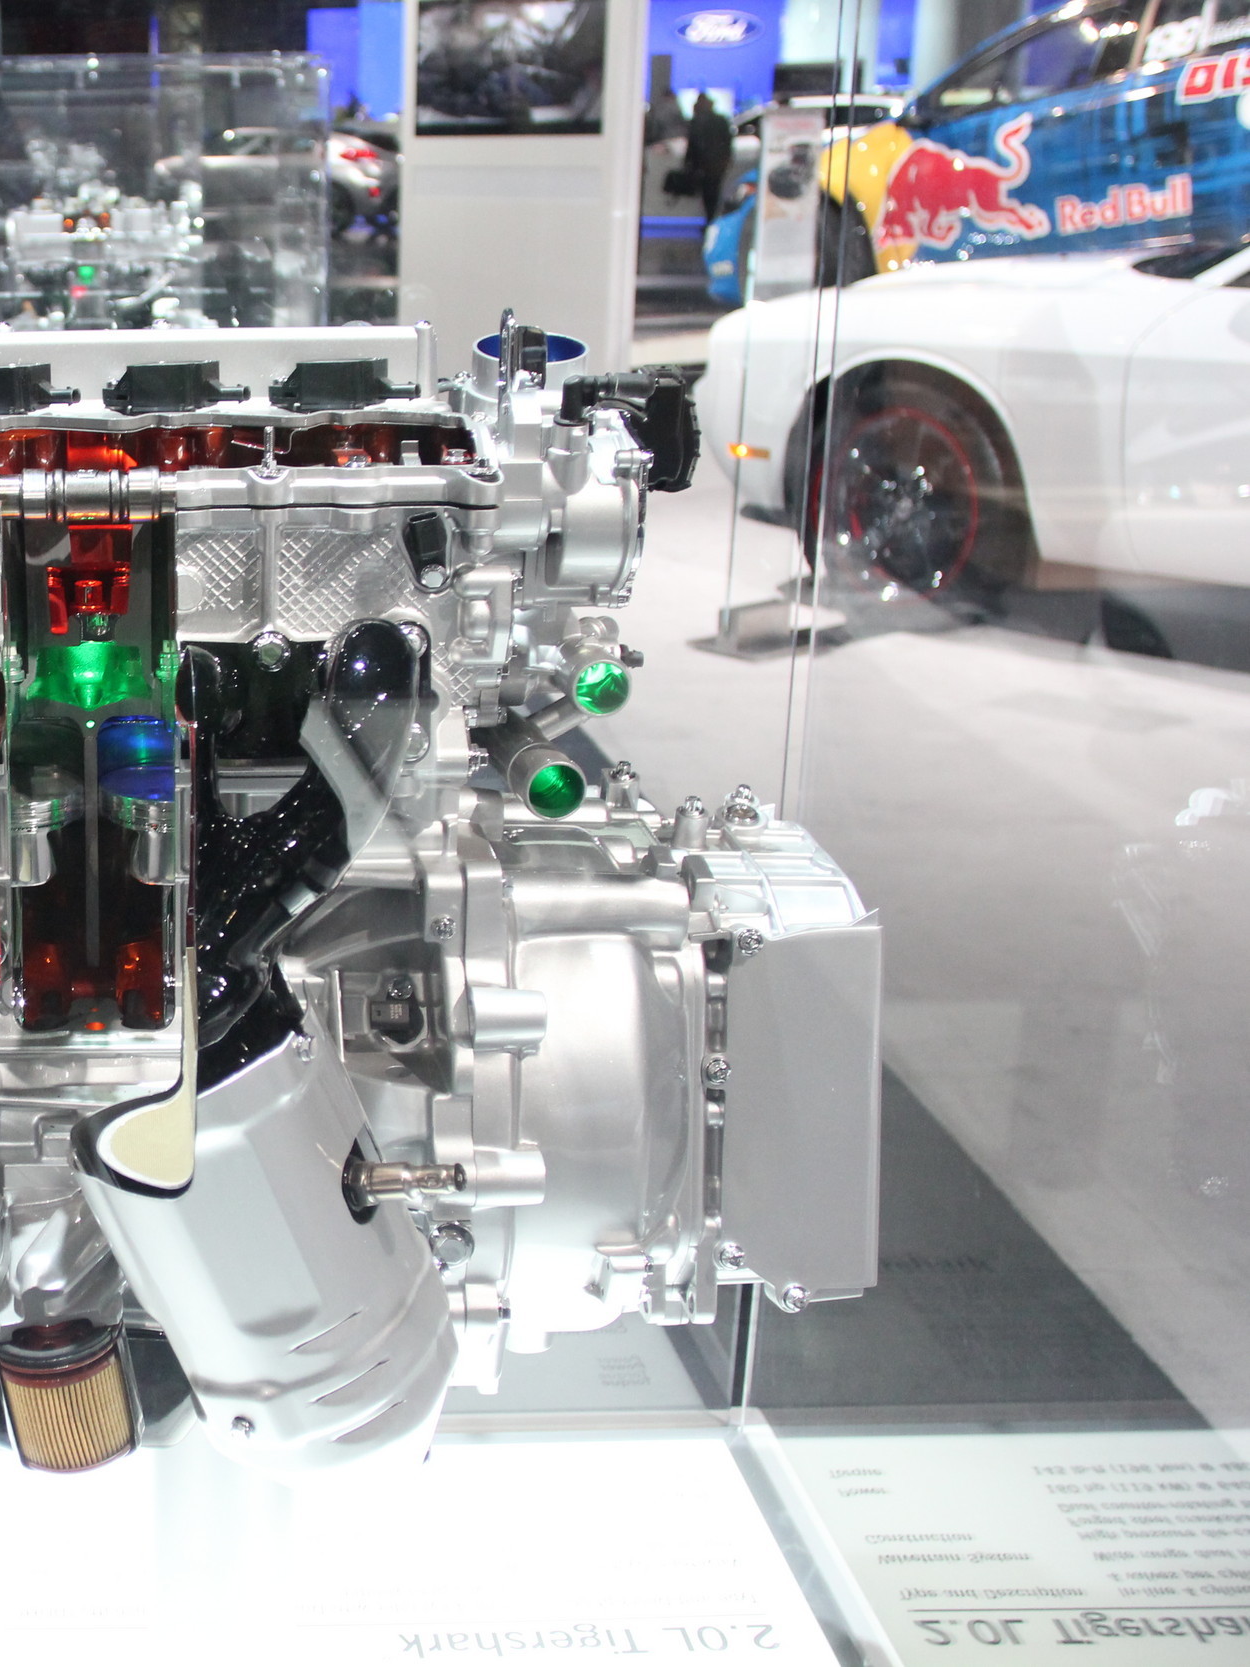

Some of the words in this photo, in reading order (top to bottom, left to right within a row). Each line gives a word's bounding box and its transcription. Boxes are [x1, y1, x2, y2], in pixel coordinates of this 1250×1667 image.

[685, 13, 748, 43] Ford
[1054, 183, 1122, 236] Red
[1123, 173, 1194, 224] Bull
[397, 1621, 649, 1661] Tigershark
[662, 1623, 781, 1654] 2.0L
